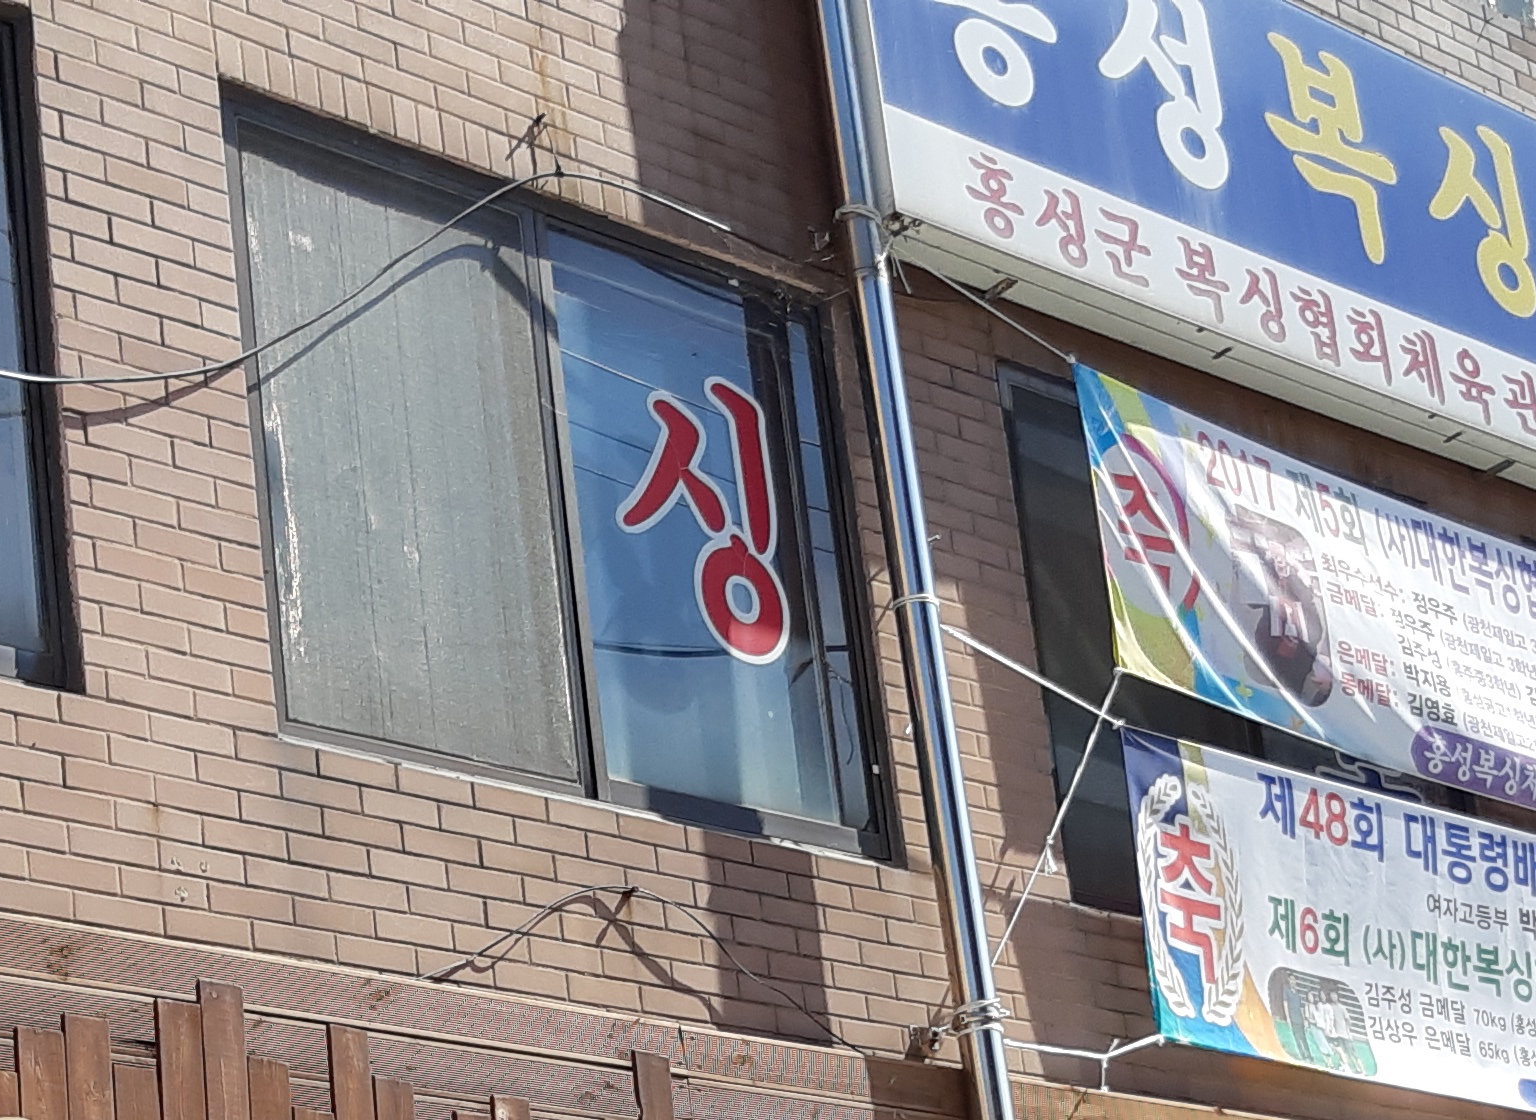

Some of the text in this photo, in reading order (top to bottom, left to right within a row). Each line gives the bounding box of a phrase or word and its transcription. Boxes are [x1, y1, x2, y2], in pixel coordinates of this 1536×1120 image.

[965, 151, 1152, 288] 홍성군
[617, 376, 791, 665] 싱
[1197, 430, 1277, 511] 2017
[1285, 468, 1369, 556] 제5회
[1256, 771, 1386, 864] 제48회
[1158, 822, 1224, 985] 축
[1266, 894, 1351, 968] 제6회
[1425, 892, 1511, 932] 여자고등부
[1363, 980, 1414, 1014] 김주성
[1419, 991, 1466, 1024] 금메달
[1473, 1006, 1507, 1034] 70kg
[1367, 1015, 1419, 1046] 김상우
[1423, 1024, 1473, 1058] 은메달
[1478, 1039, 1511, 1065] 65kg
